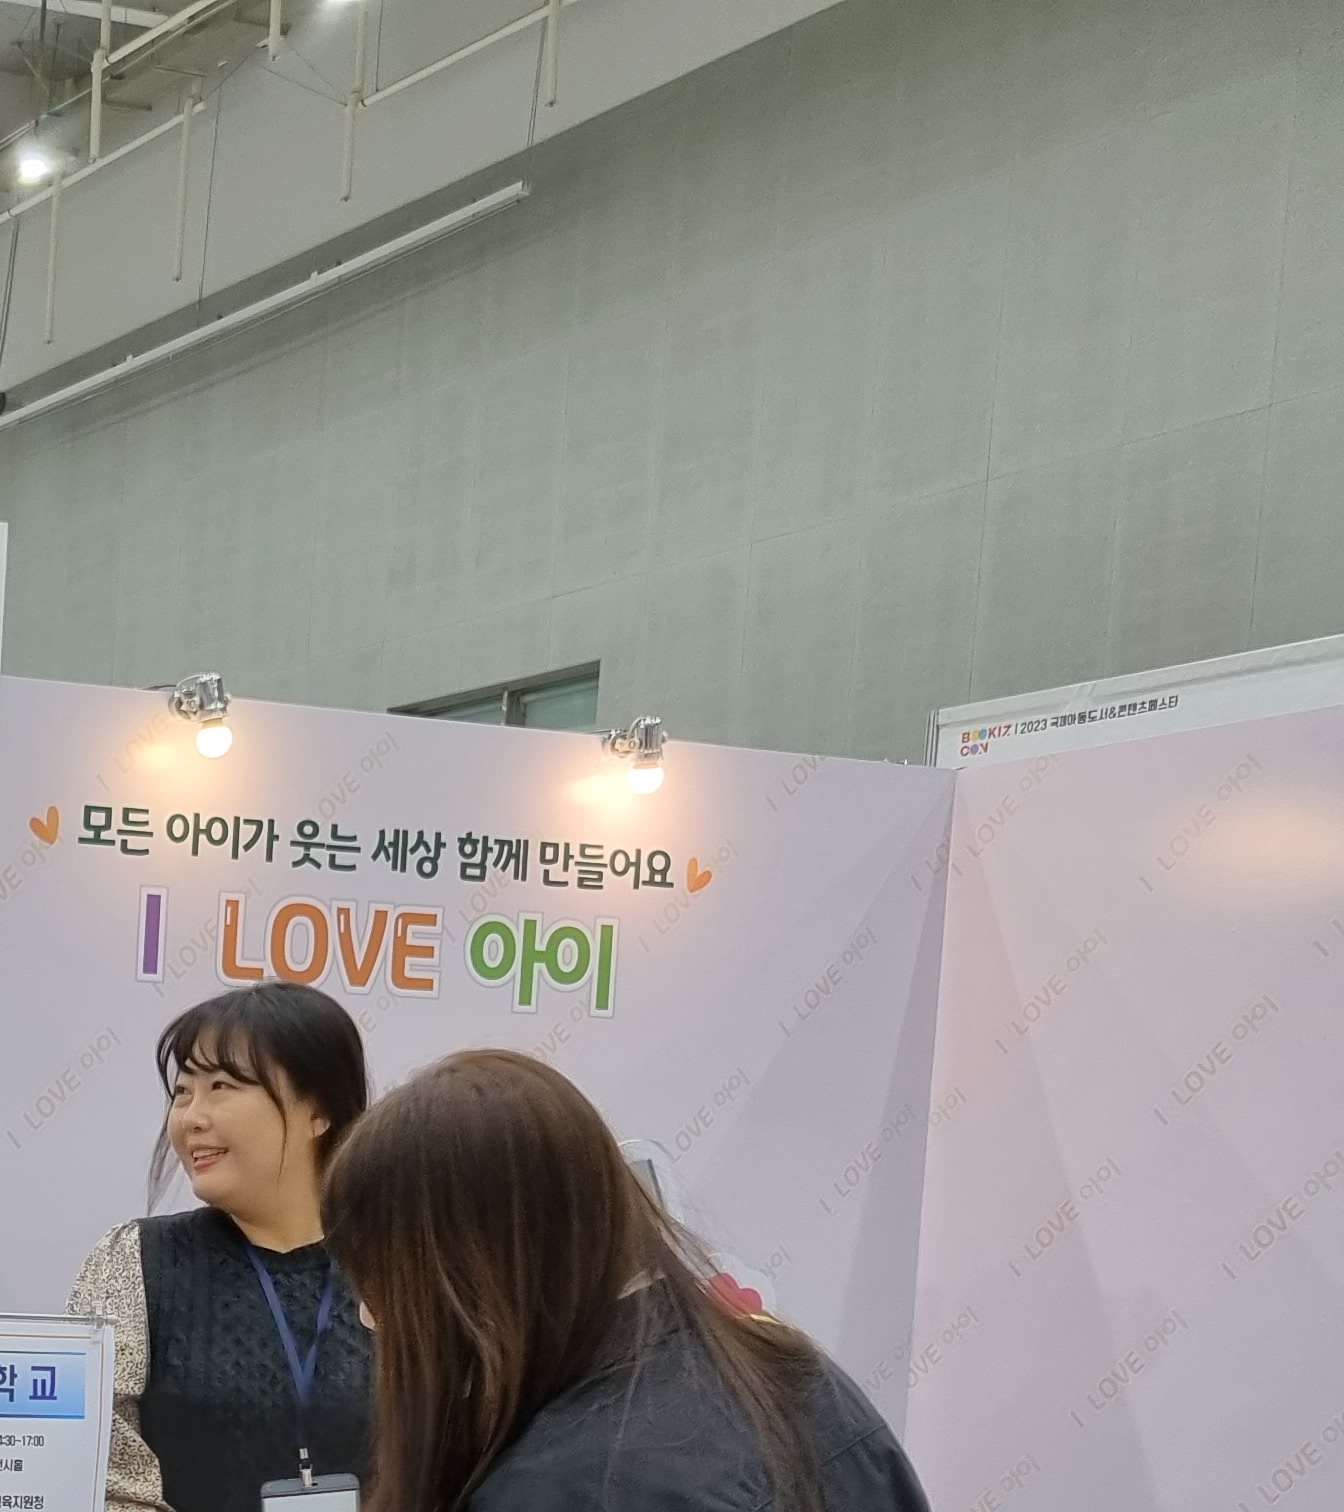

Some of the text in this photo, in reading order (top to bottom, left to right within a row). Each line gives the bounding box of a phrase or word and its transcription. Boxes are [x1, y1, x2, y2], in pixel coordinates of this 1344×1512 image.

[960, 742, 989, 759] CON
[1020, 717, 1048, 735] 2023
[78, 804, 674, 890] 모든 아이가 웃는 세상 함께 만들어요
[141, 891, 615, 1012] I LOVE 아이
[793, 966, 844, 1021] LOVE
[22, 1068, 81, 1132] LOVE
[1169, 1041, 1232, 1107] LOVE
[1023, 1199, 1081, 1263] LOVE
[1087, 1351, 1147, 1412] LOVE
